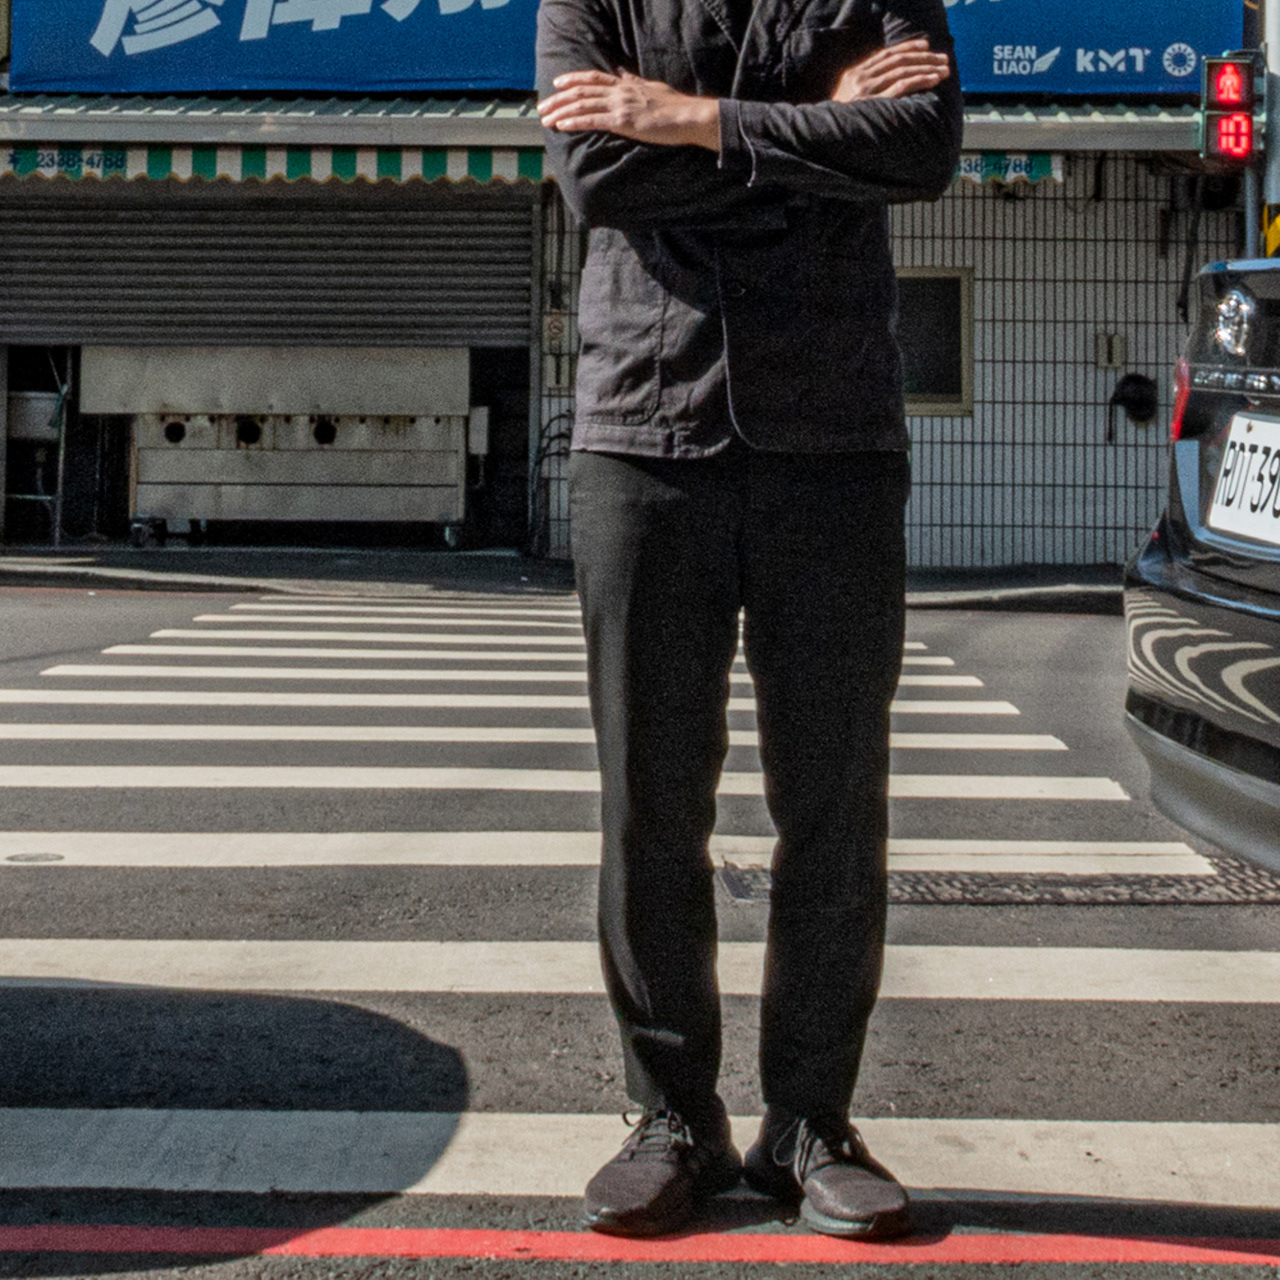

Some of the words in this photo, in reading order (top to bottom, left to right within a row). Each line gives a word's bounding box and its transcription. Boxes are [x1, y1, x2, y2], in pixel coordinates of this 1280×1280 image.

[993, 45, 1037, 60] SEAN
[1076, 46, 1152, 73] KMT
[993, 61, 1031, 76] LIAO
[956, 157, 1034, 174] 38-4788
